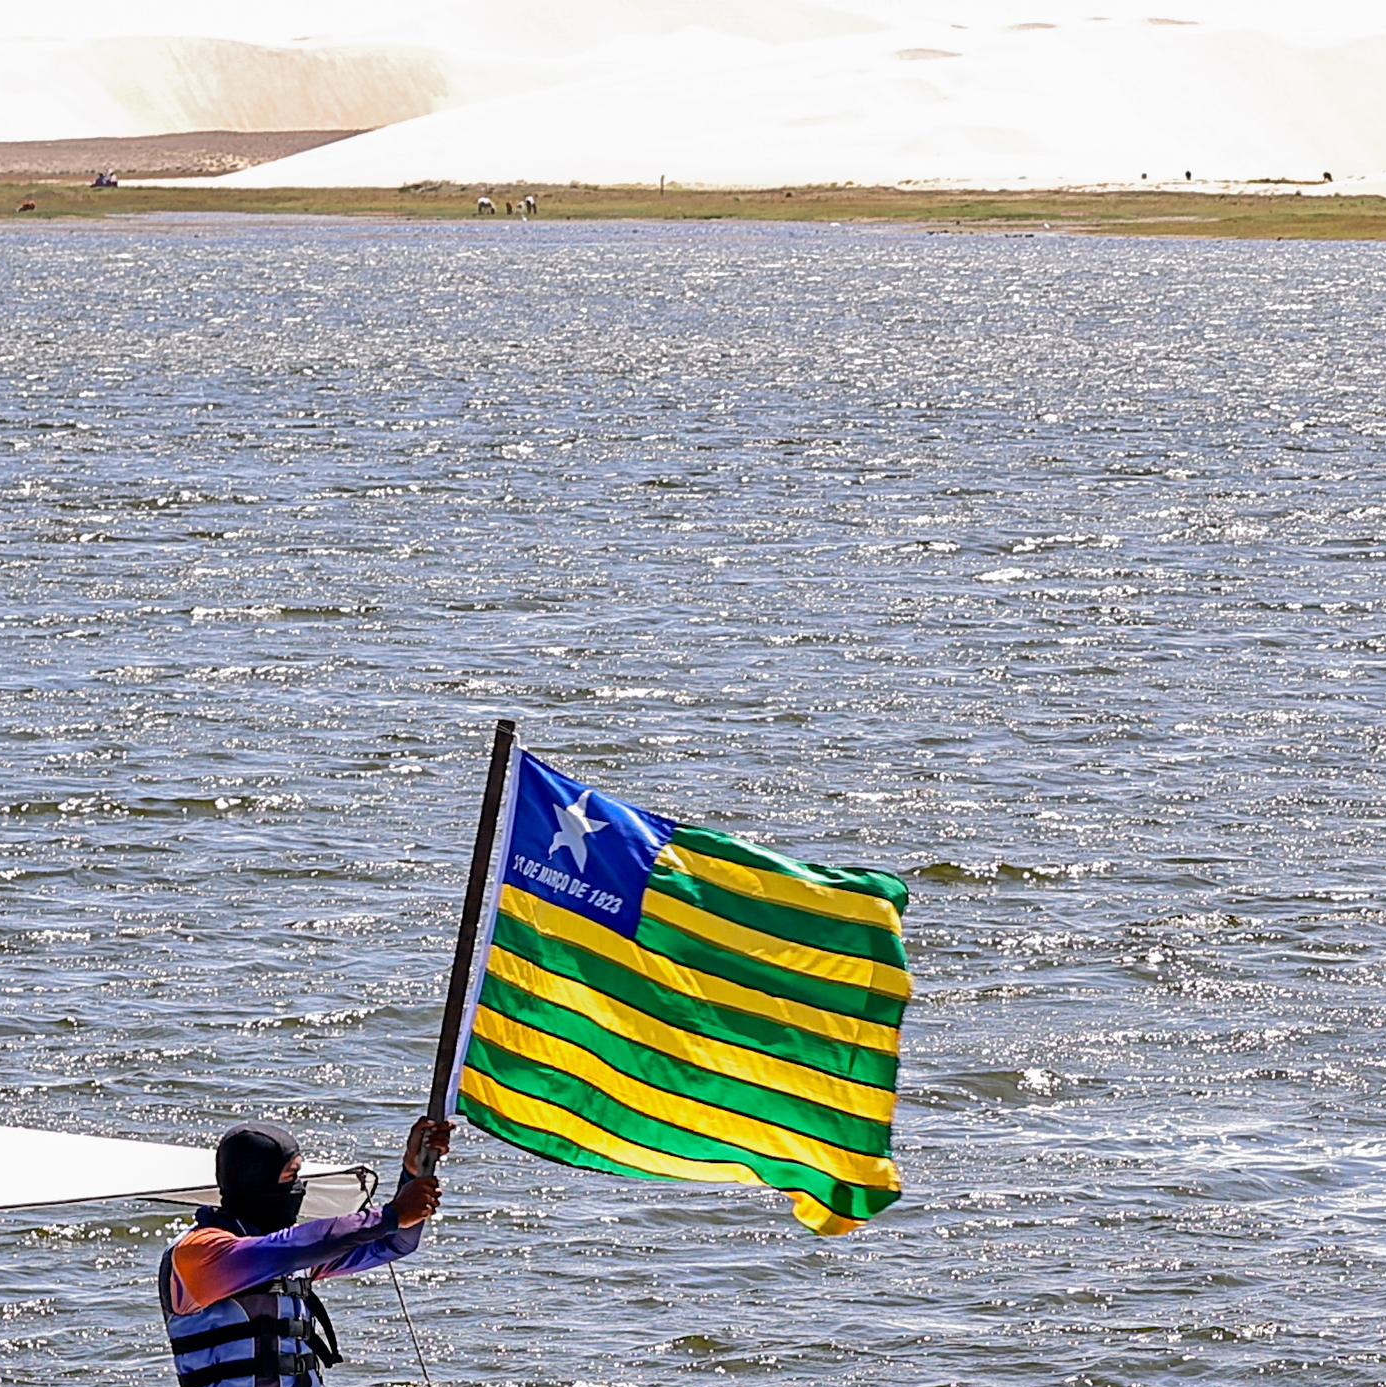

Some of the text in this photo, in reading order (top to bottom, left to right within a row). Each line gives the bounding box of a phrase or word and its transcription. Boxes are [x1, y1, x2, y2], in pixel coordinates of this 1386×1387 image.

[522, 860, 542, 880] DE
[535, 866, 571, 893] MARÇO
[567, 879, 591, 899] DE
[587, 889, 623, 914] 1823
